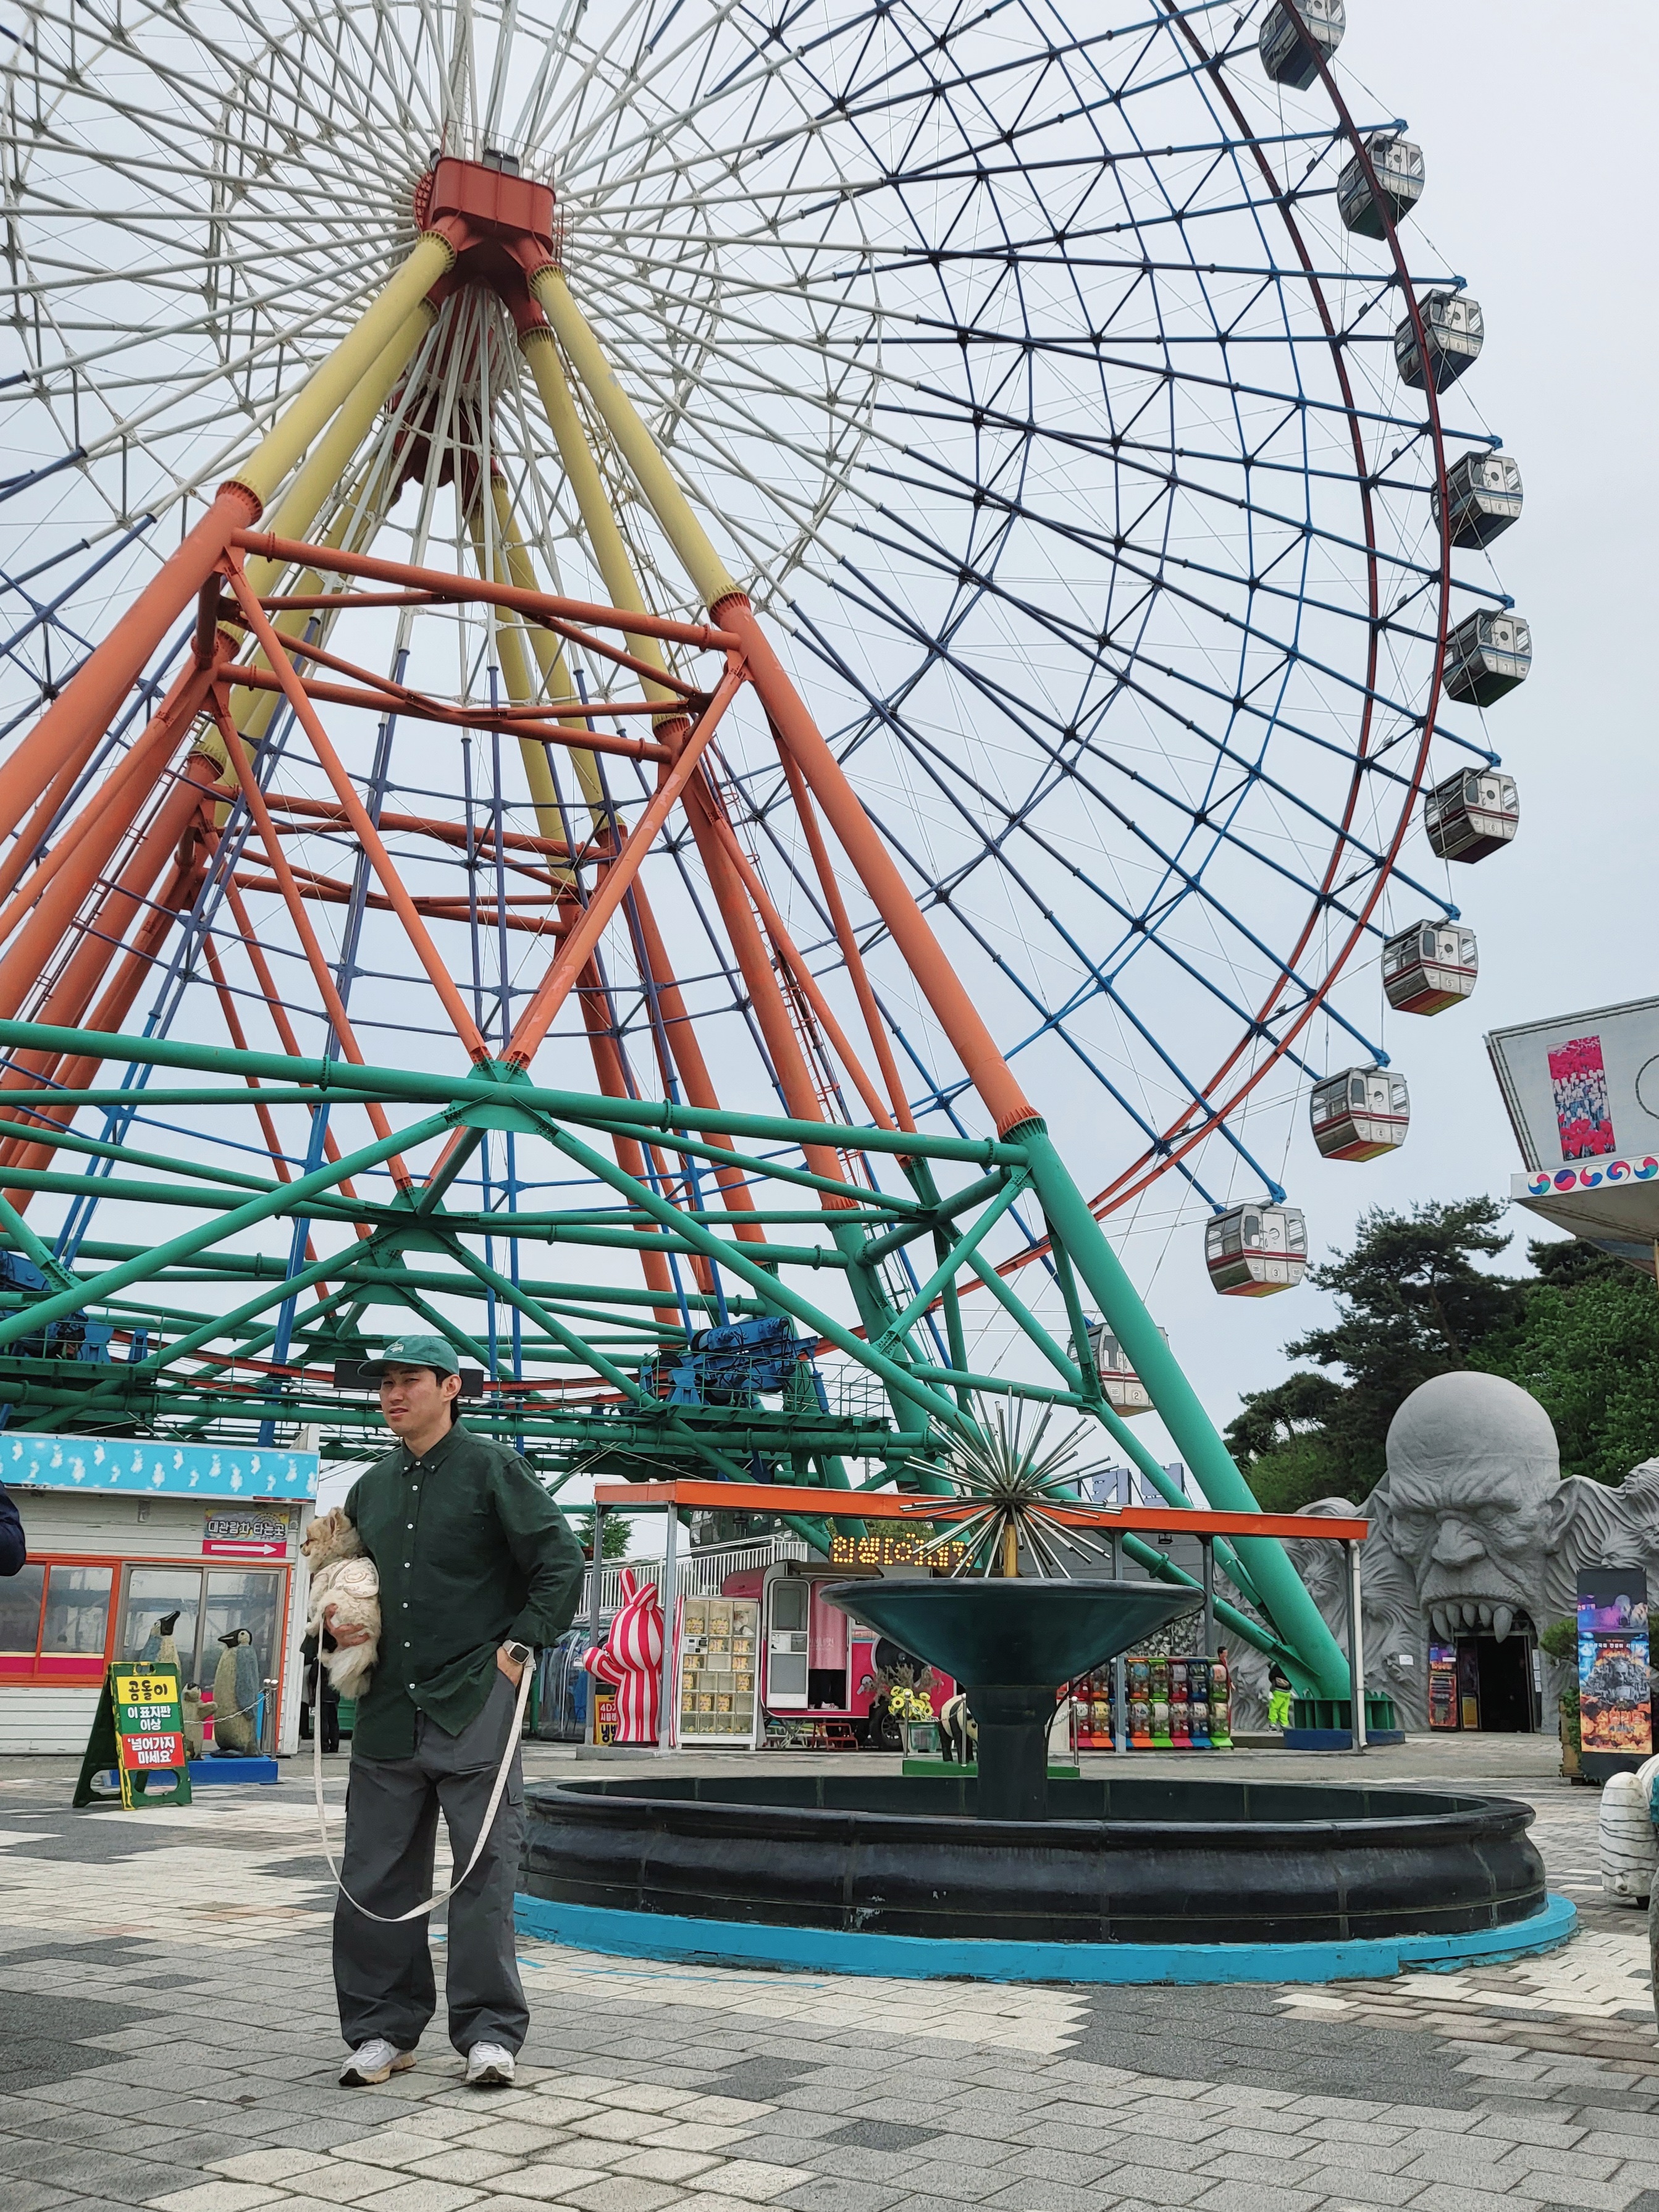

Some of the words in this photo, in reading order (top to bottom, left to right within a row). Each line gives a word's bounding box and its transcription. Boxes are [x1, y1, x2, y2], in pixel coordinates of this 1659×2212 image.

[1134, 1392, 1139, 1400] 2
[208, 1521, 250, 1534] 대관람차
[128, 1680, 168, 1701] 곰돌이
[127, 1706, 138, 1718] 이
[140, 1705, 171, 1718] 표지판
[140, 1718, 161, 1730] 이상
[127, 1736, 175, 1751] '넘어가지
[138, 1749, 174, 1764] 마세요'
